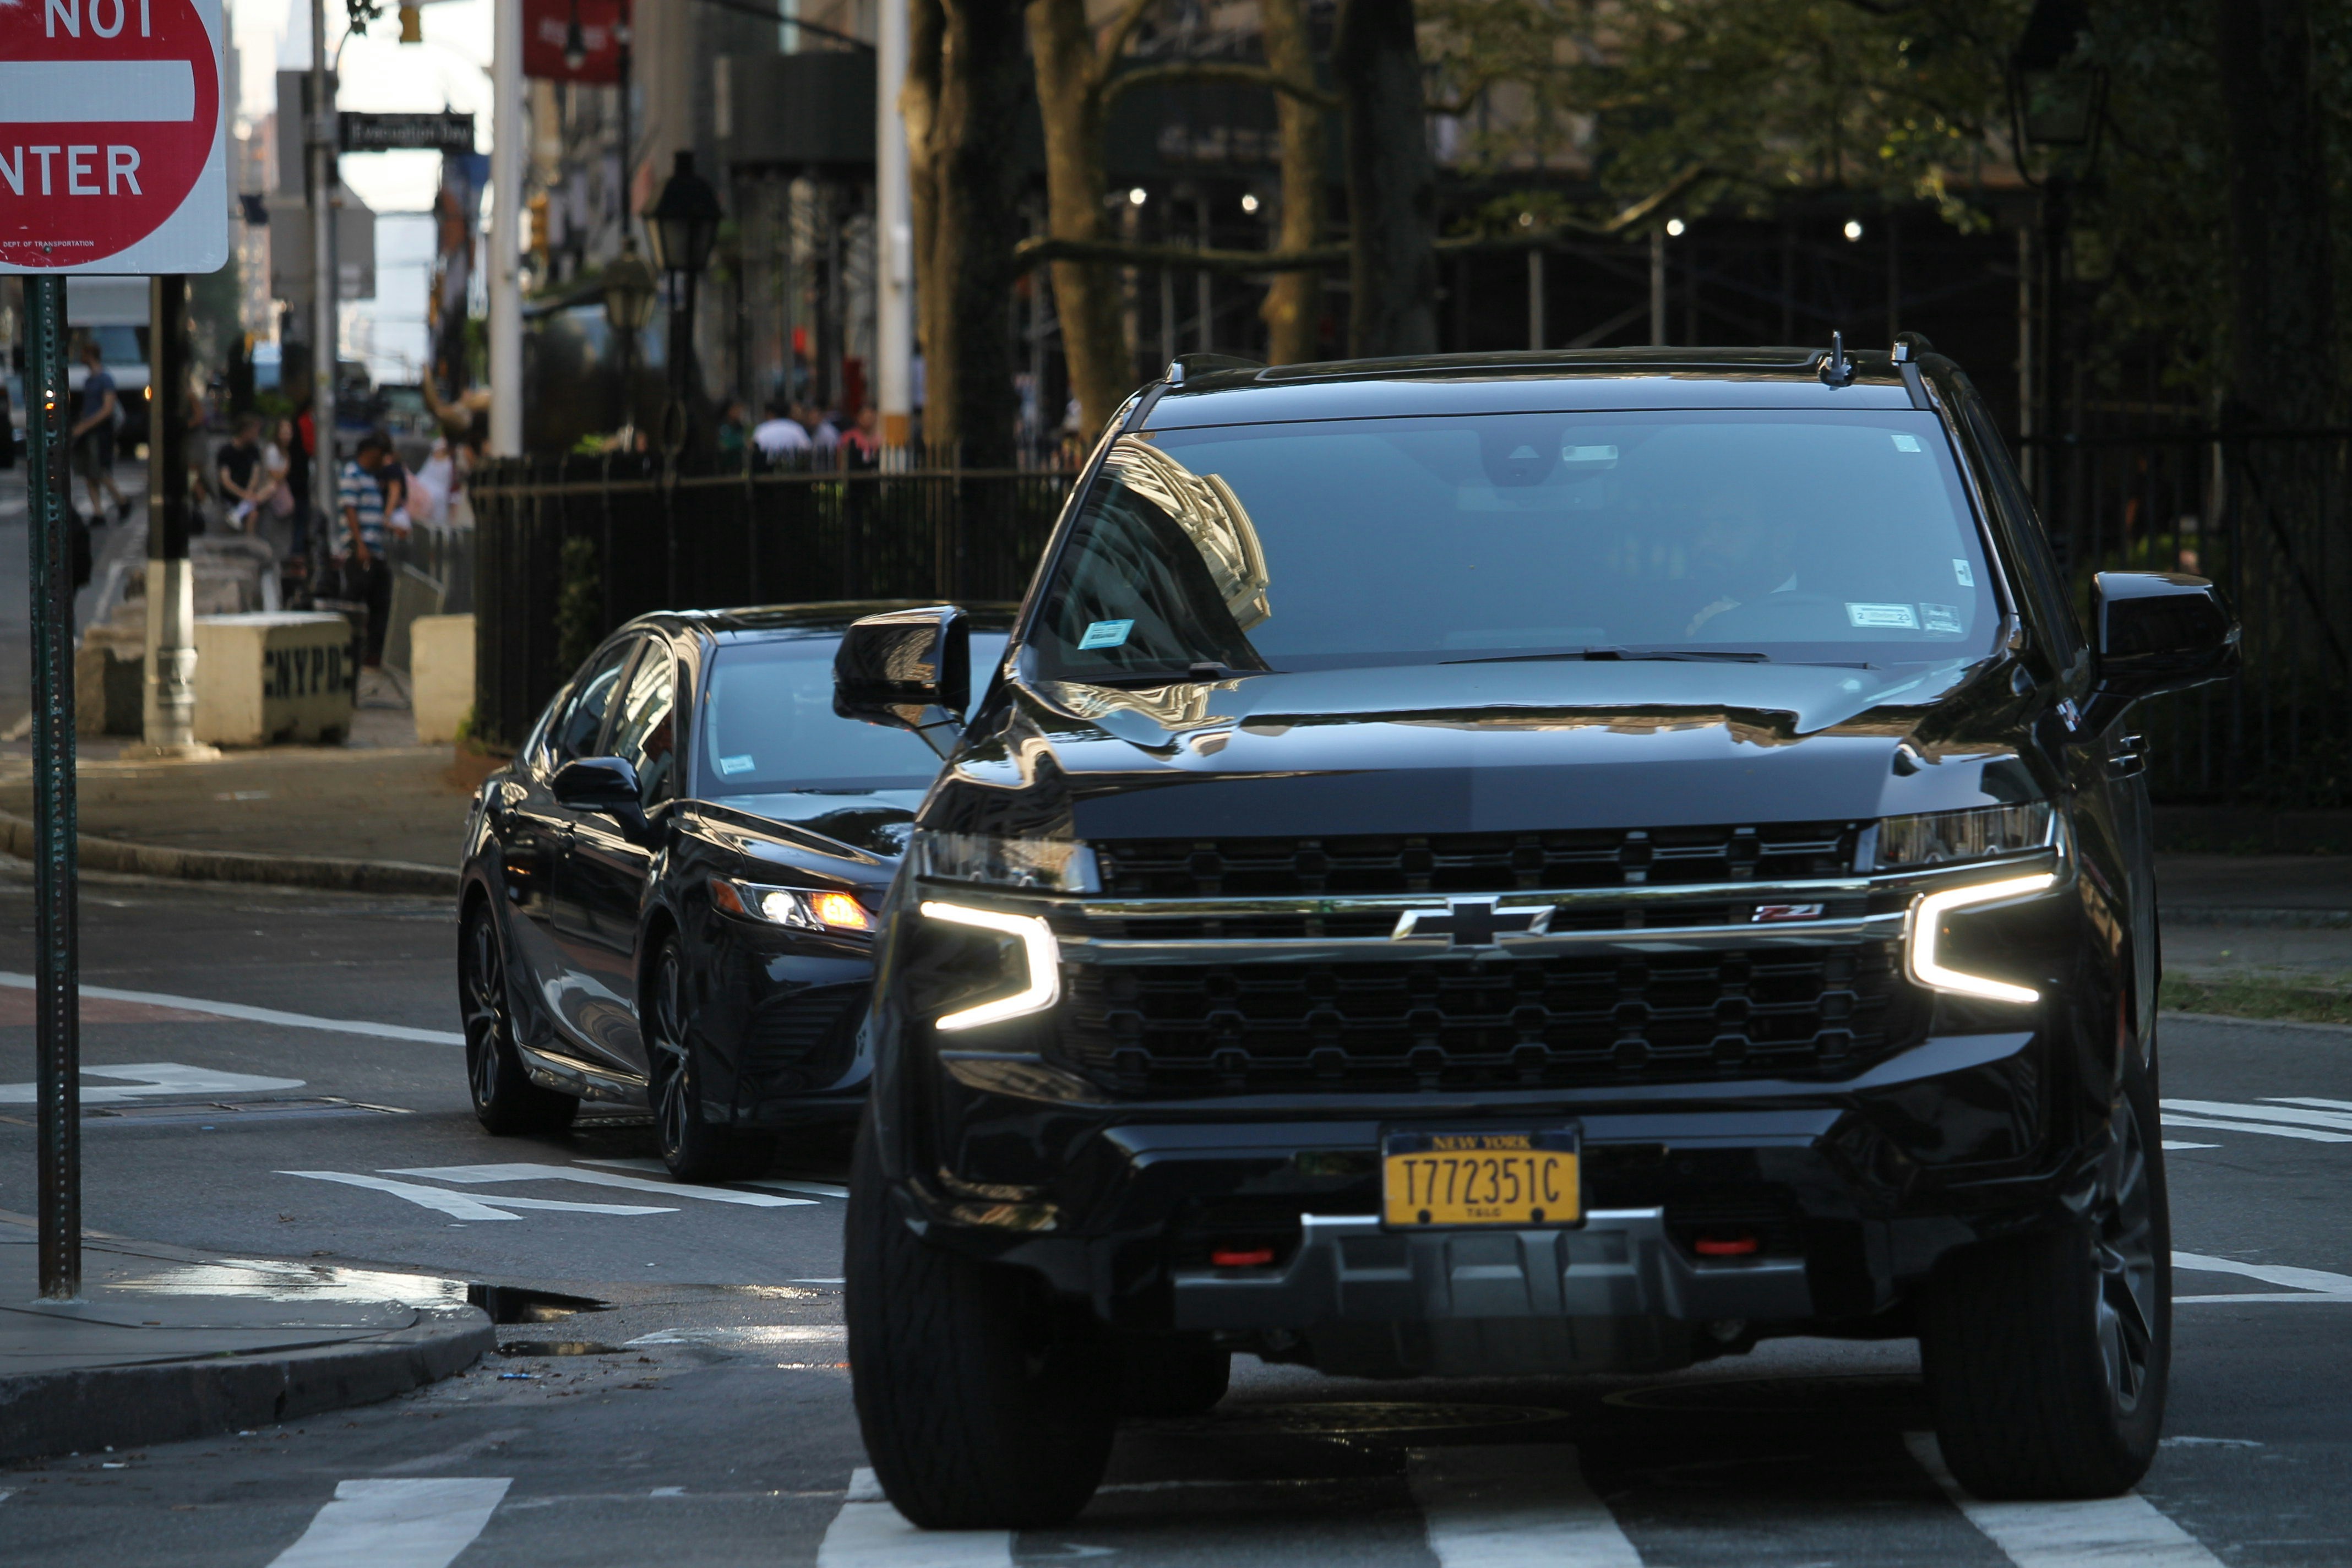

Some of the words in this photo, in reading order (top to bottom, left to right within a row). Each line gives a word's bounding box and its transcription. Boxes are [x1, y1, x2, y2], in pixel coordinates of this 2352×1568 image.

[45, 0, 150, 38] NOT
[0, 145, 143, 195] NTER
[277, 646, 340, 698] NYPD
[1433, 1136, 1478, 1149] NEW
[1483, 1136, 1531, 1148] YORK
[1402, 1158, 1560, 1205] T772351C
